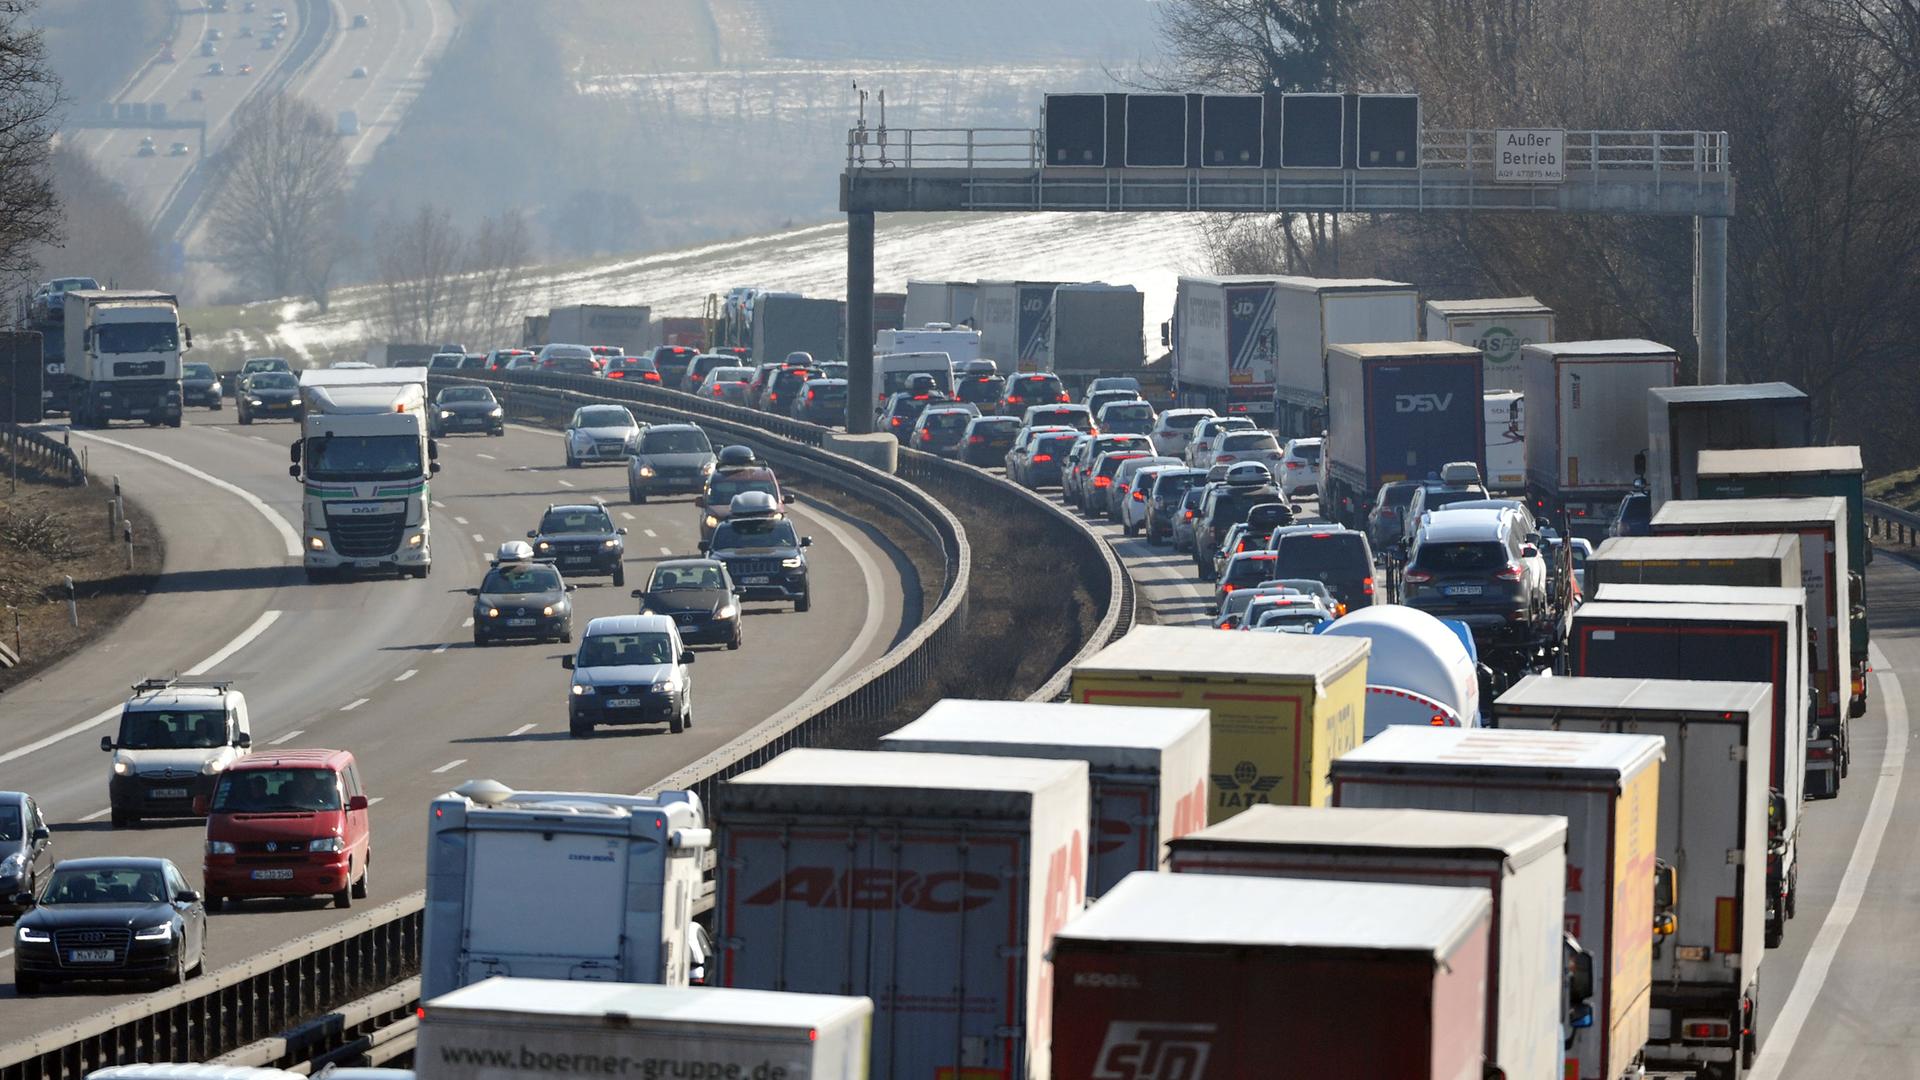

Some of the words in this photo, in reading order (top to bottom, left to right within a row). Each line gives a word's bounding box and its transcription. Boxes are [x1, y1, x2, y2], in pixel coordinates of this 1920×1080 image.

[1506, 133, 1552, 147] Außer
[1503, 152, 1556, 165] Betrieb
[1232, 302, 1253, 315] JD
[1395, 393, 1453, 412] DSV
[1219, 792, 1269, 807] IATA
